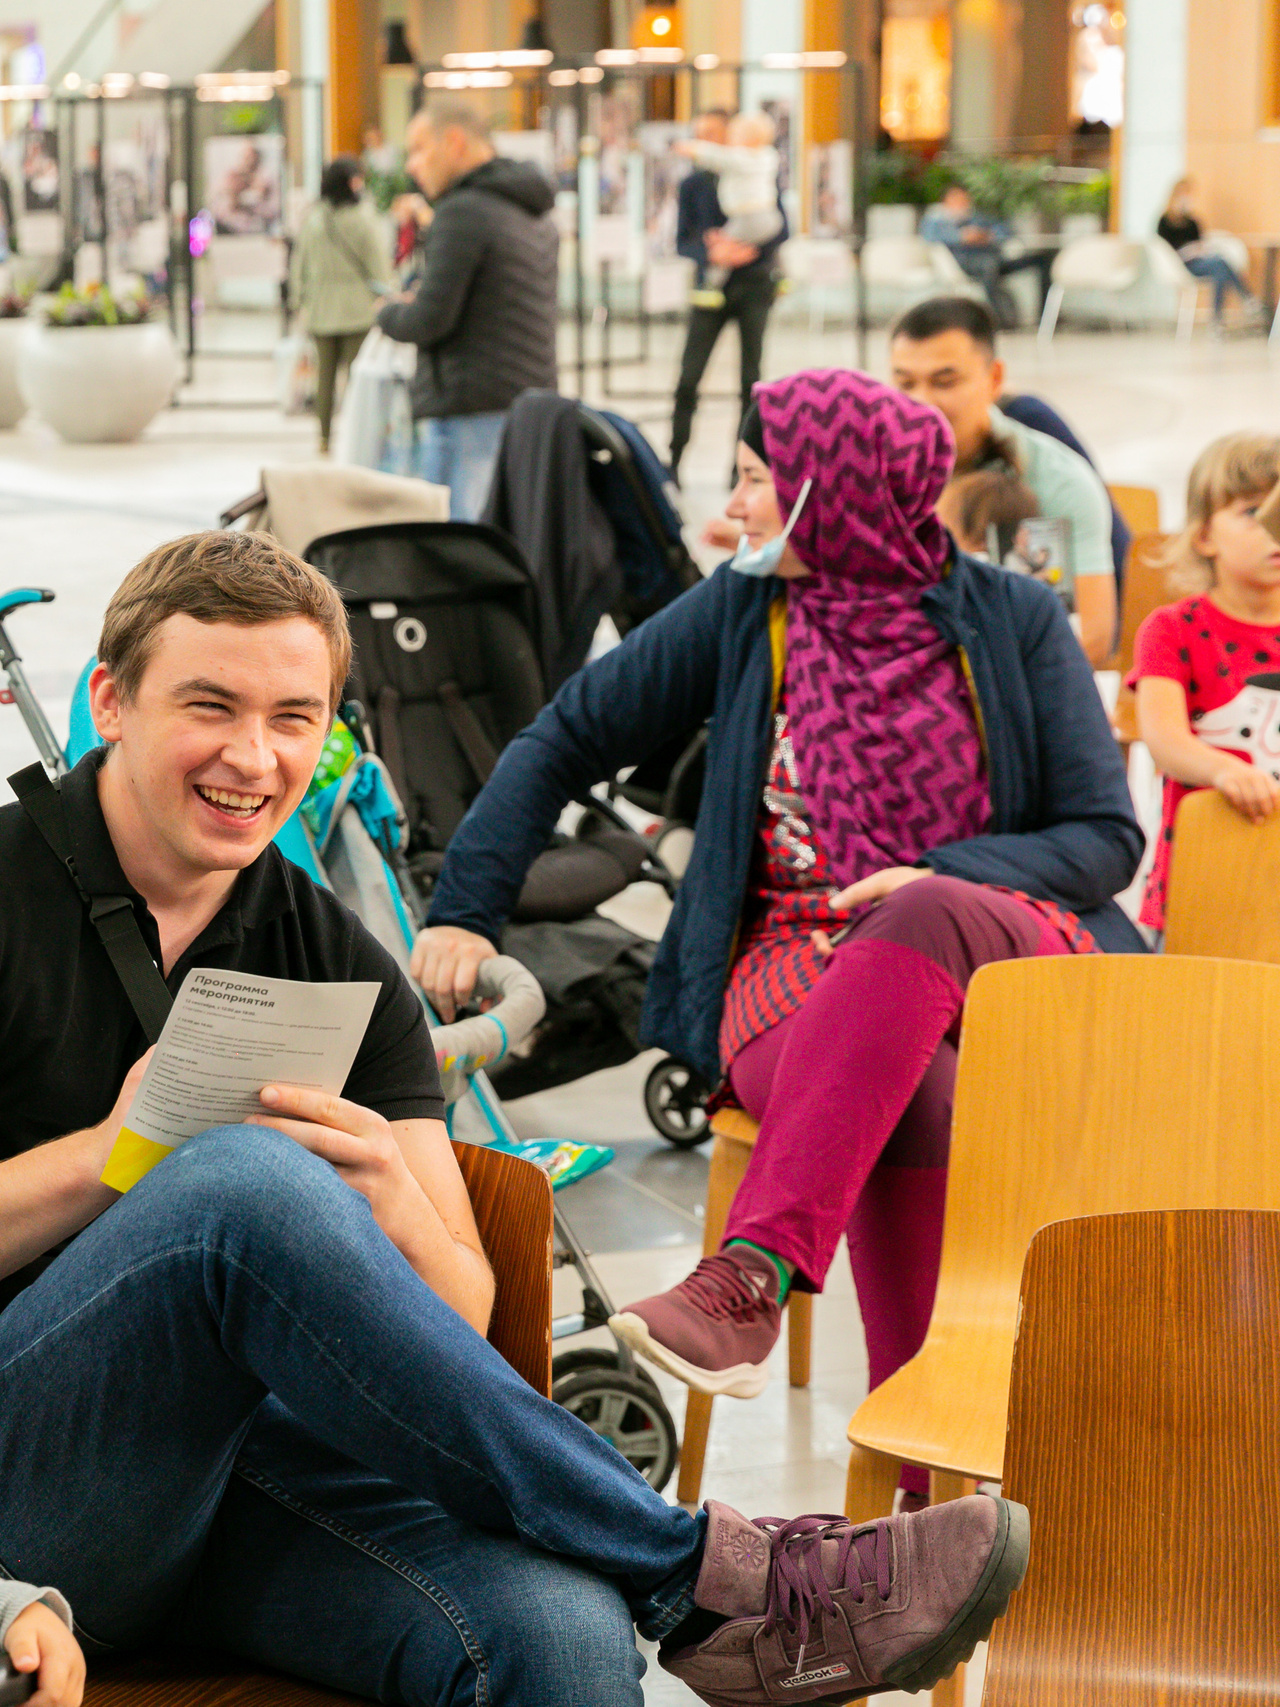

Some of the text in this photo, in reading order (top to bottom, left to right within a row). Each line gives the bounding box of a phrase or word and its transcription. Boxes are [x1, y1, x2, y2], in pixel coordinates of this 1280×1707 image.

[194, 975, 269, 996] Программа
[190, 986, 275, 1008] мероприятия
[780, 1669, 832, 1687] Reebok
